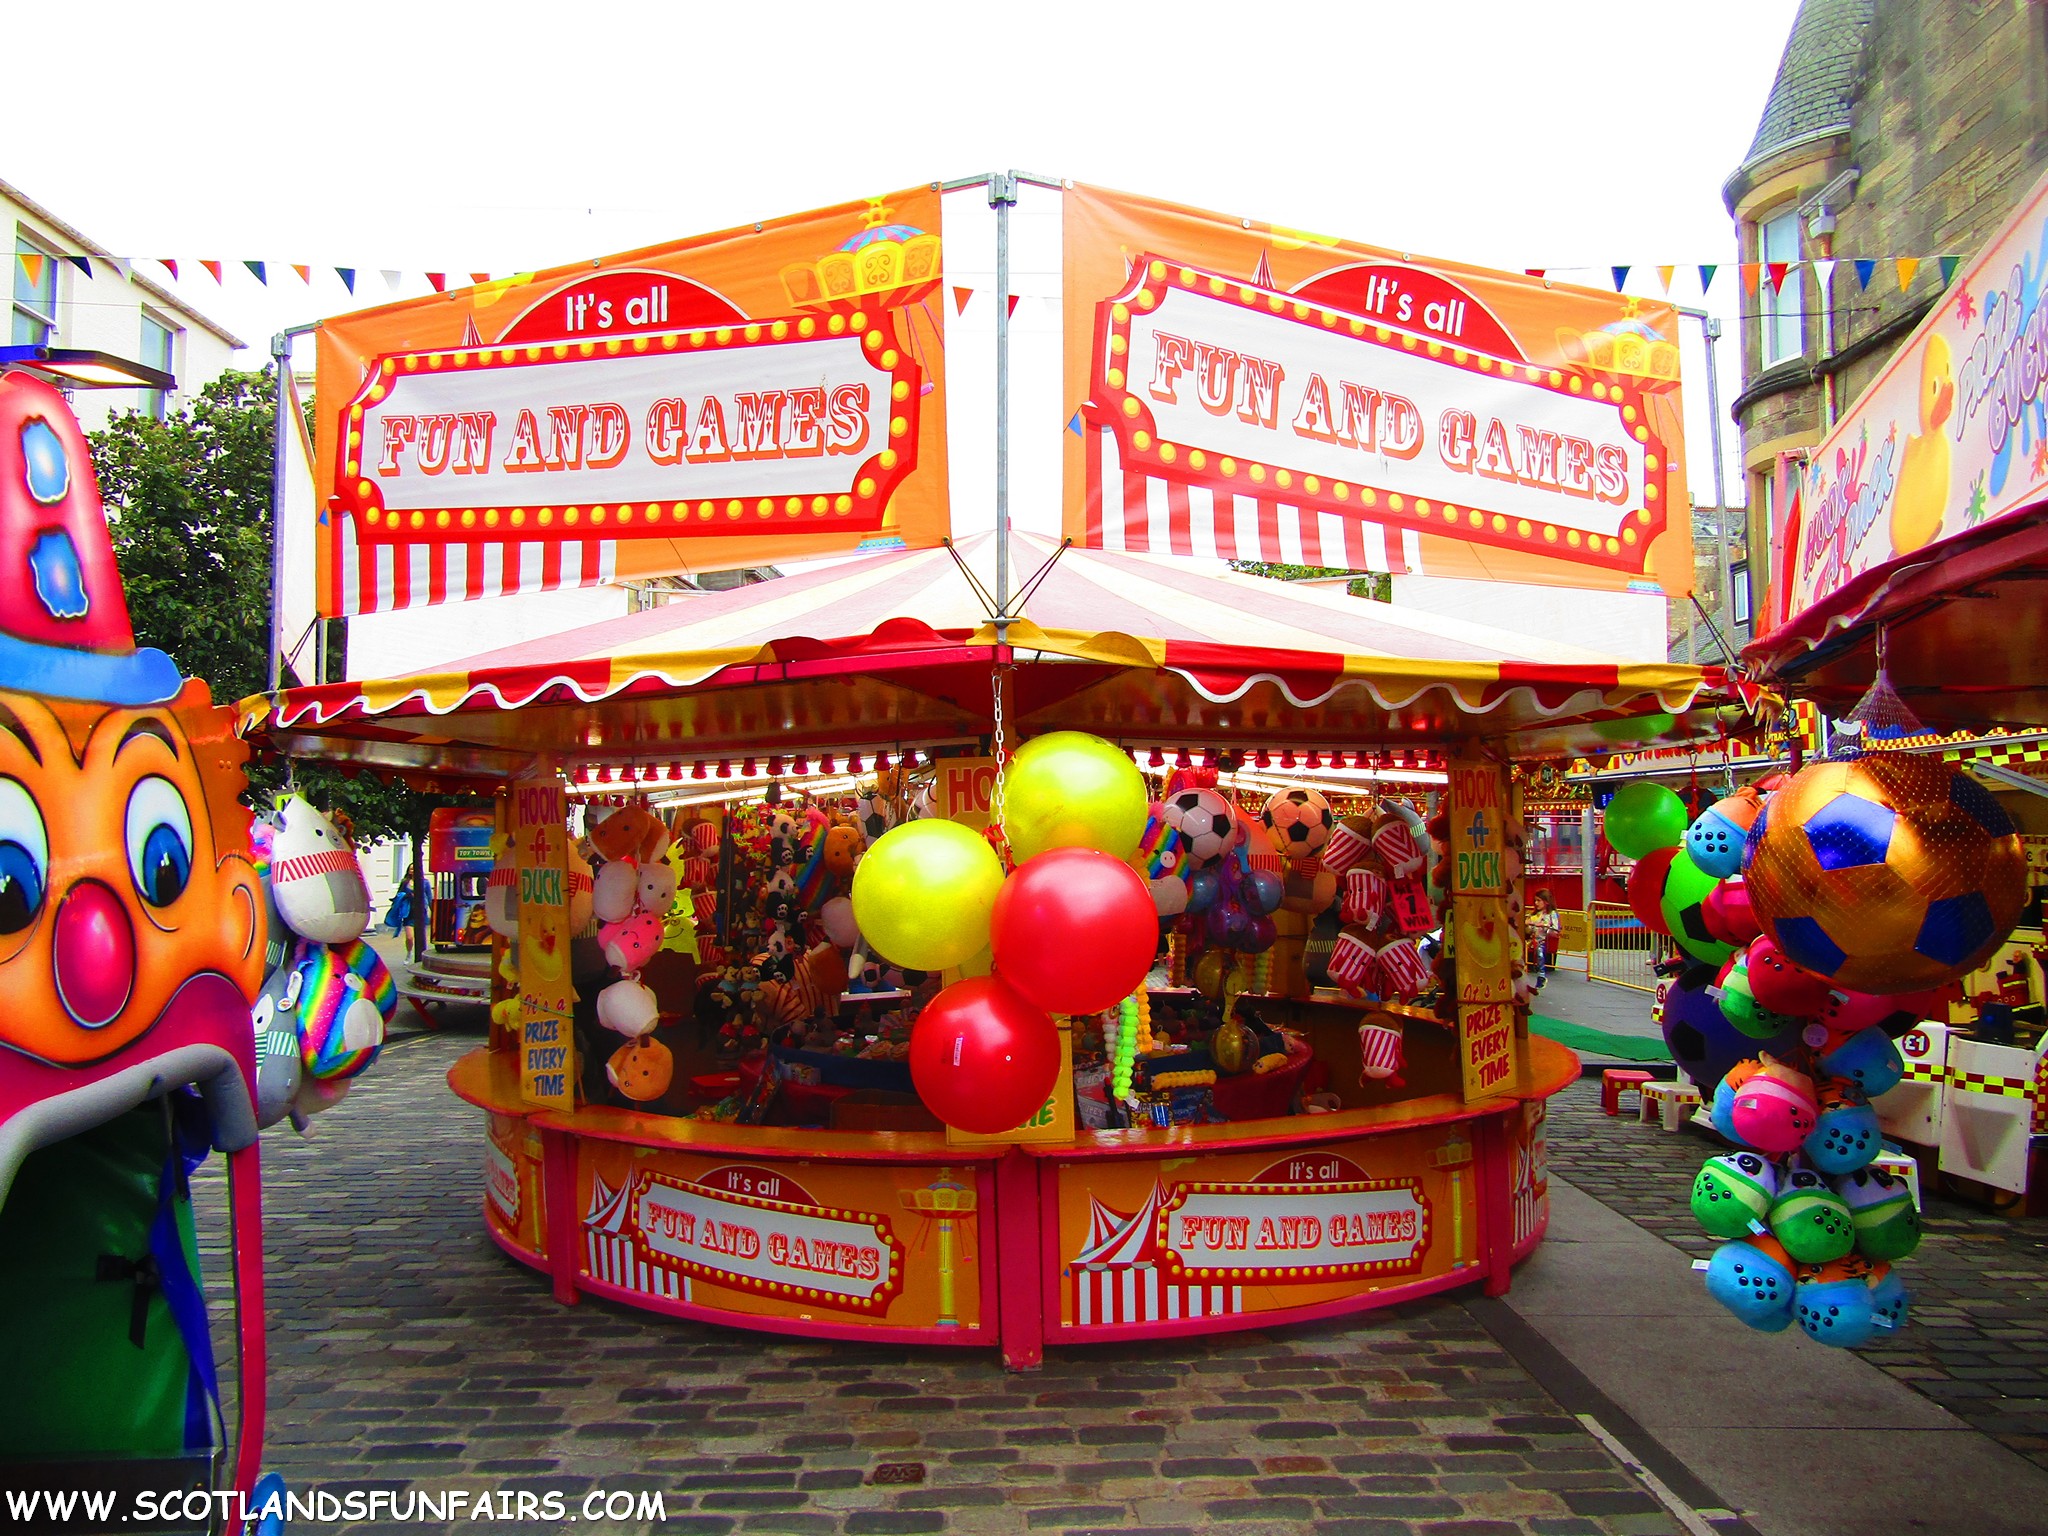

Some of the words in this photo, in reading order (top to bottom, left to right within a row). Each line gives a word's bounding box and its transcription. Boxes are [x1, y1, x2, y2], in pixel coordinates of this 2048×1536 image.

[566, 294, 613, 332] It's
[625, 286, 669, 325] all
[1364, 274, 1414, 321] It's
[1423, 300, 1466, 338] all
[377, 411, 499, 478] FUN
[504, 402, 631, 474] AND
[645, 383, 871, 466] GAMES
[1149, 329, 1286, 431] FUN
[1293, 373, 1425, 461] AND
[1439, 407, 1630, 505] GAMES
[1803, 458, 1850, 581] HOOK
[1842, 438, 1895, 565] DUCK
[1823, 532, 1840, 597] A
[518, 786, 561, 829] HOOK
[1453, 768, 1499, 811] HOOK
[529, 828, 552, 865] A
[1466, 810, 1490, 848] A
[521, 867, 563, 906] DUCK
[1458, 851, 1502, 890] DUCK
[1403, 916, 1430, 928] WIN
[1405, 895, 1417, 915] 1
[523, 993, 549, 1016] It's
[555, 997, 567, 1013] a
[1463, 981, 1491, 1007] It's
[1497, 978, 1508, 992] a
[524, 1019, 560, 1045] PRIZE
[1466, 1002, 1503, 1040] PRIZE
[527, 1047, 567, 1071] EVERY
[1471, 1024, 1510, 1066] EVERY
[1904, 1034, 1926, 1052] £1
[534, 1074, 565, 1098] TIME
[1478, 1059, 1511, 1090] TIME
[727, 1171, 752, 1191] It's
[757, 1177, 780, 1197] all
[1289, 1162, 1316, 1180] It's
[1319, 1160, 1339, 1180] all
[646, 1201, 697, 1245] FUN
[699, 1217, 761, 1260] AND
[768, 1231, 881, 1280] GAMES
[1179, 1214, 1250, 1250] FUN
[1253, 1214, 1322, 1250] AND
[1327, 1208, 1418, 1247] GAMES
